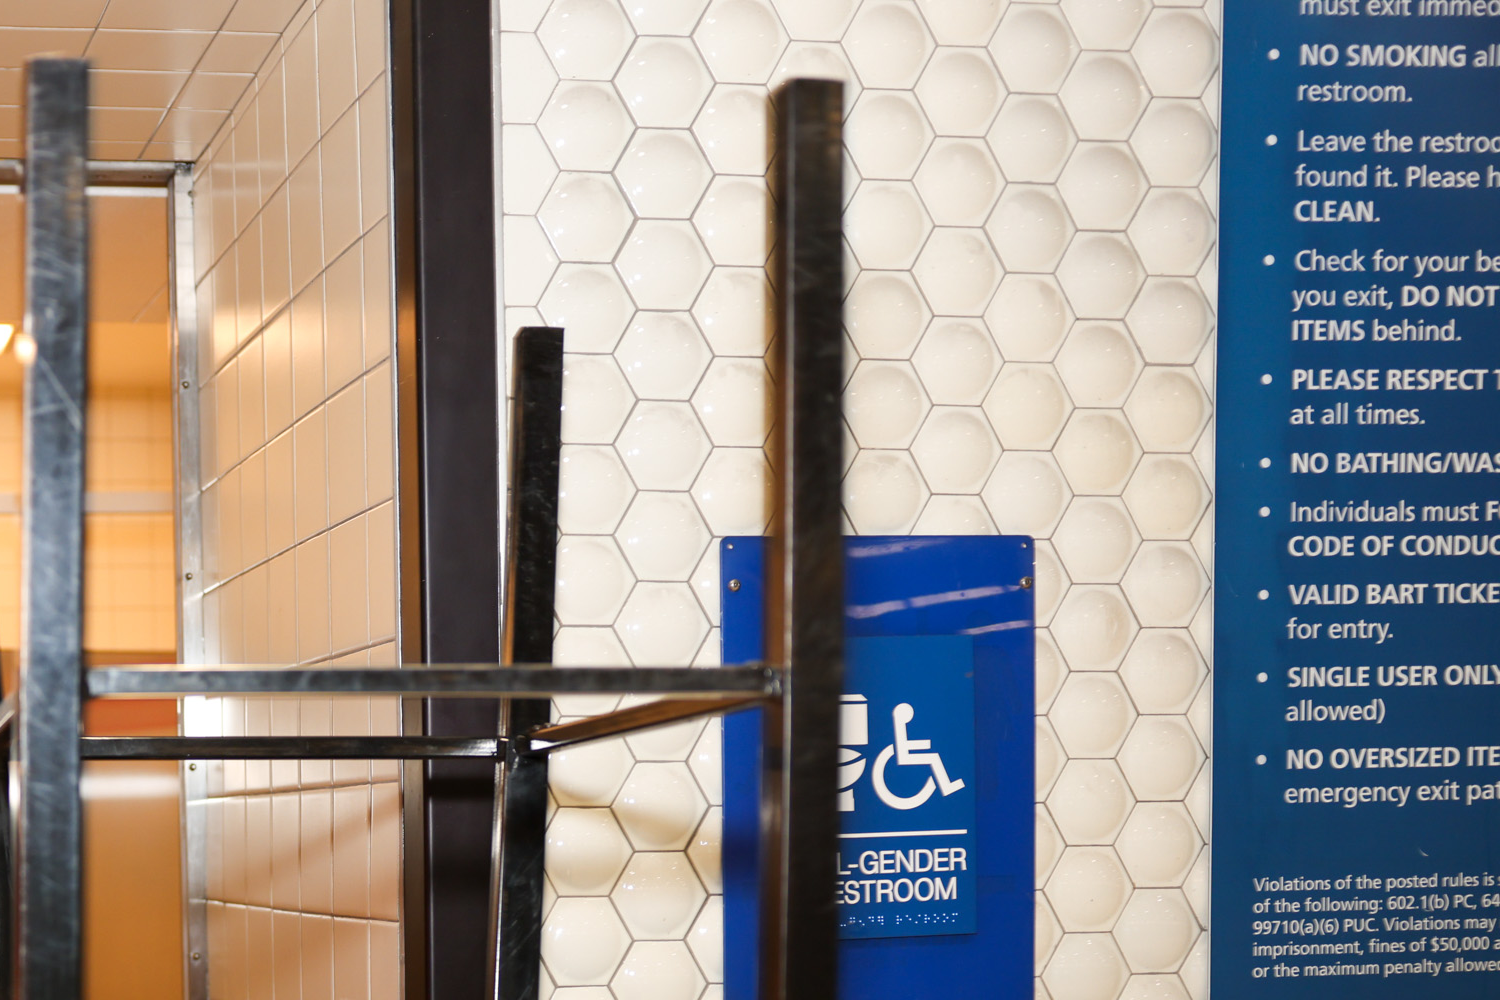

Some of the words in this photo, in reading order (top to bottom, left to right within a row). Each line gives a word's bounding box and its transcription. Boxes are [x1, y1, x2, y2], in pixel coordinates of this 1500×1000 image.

[1299, 0, 1359, 16] must
[1365, 0, 1411, 16] exit
[1300, 44, 1339, 66] NO
[1346, 44, 1466, 67] SMOKING
[1298, 82, 1412, 102] restroom.
[1297, 130, 1366, 152] Leave
[1372, 129, 1413, 152] the
[1295, 163, 1367, 187] found
[1375, 165, 1398, 187] it.
[1406, 165, 1480, 187] Please
[1294, 200, 1380, 222] CLEAN.
[1294, 249, 1365, 271] Check
[1372, 249, 1409, 272] for
[1414, 255, 1469, 277] your
[1291, 290, 1336, 312] you
[1343, 284, 1393, 310] exit,
[1401, 286, 1440, 307] DO
[1446, 286, 1499, 307] NOT
[1291, 320, 1365, 341] ITEMS
[1372, 319, 1462, 341] behind.
[1292, 369, 1379, 390] PLEASE
[1386, 369, 1488, 390] RESPECT
[1289, 404, 1314, 424] at
[1321, 402, 1348, 424] all
[1355, 403, 1425, 425] times.
[1291, 452, 1329, 473] NO
[1290, 500, 1415, 522] Individuals
[1422, 502, 1479, 522] must
[1288, 536, 1354, 557] CODE
[1362, 536, 1394, 556] OF
[1288, 584, 1359, 604] VALID
[1366, 584, 1428, 604] BART
[1433, 583, 1500, 604] TICKE
[1286, 617, 1322, 639] for
[1328, 620, 1393, 644] entry.
[1287, 666, 1370, 687] SINGLE
[1377, 665, 1438, 686] USER
[1285, 699, 1385, 724] allowed)
[1286, 749, 1323, 769] NO
[1330, 747, 1460, 769] OVERSIZED
[1467, 747, 1500, 766] ITE
[1284, 786, 1411, 808] emergency
[1417, 780, 1460, 801] exit
[1253, 877, 1331, 892] Violations
[1334, 875, 1352, 890] of
[1355, 875, 1382, 889] the
[1385, 873, 1438, 892] posted
[1442, 873, 1479, 887] rules
[1482, 872, 1495, 886] is
[1252, 898, 1270, 913] of
[1274, 897, 1300, 913] the
[1304, 896, 1383, 914] following:
[1387, 894, 1449, 911] 602.1(b)
[1453, 894, 1477, 910] PC,
[1252, 918, 1340, 936] 99710(a)(6)
[1343, 918, 1379, 933] PUC.
[1383, 916, 1460, 932] Violations
[1464, 917, 1497, 933] may
[1253, 939, 1364, 960] imprisonment,
[1368, 939, 1406, 953] fines
[1409, 938, 1426, 952] of
[1430, 936, 1490, 953] $50,000
[1252, 965, 1270, 978] or
[1273, 963, 1300, 977] the
[1303, 961, 1380, 977] maximum
[1383, 958, 1442, 978] penalty
